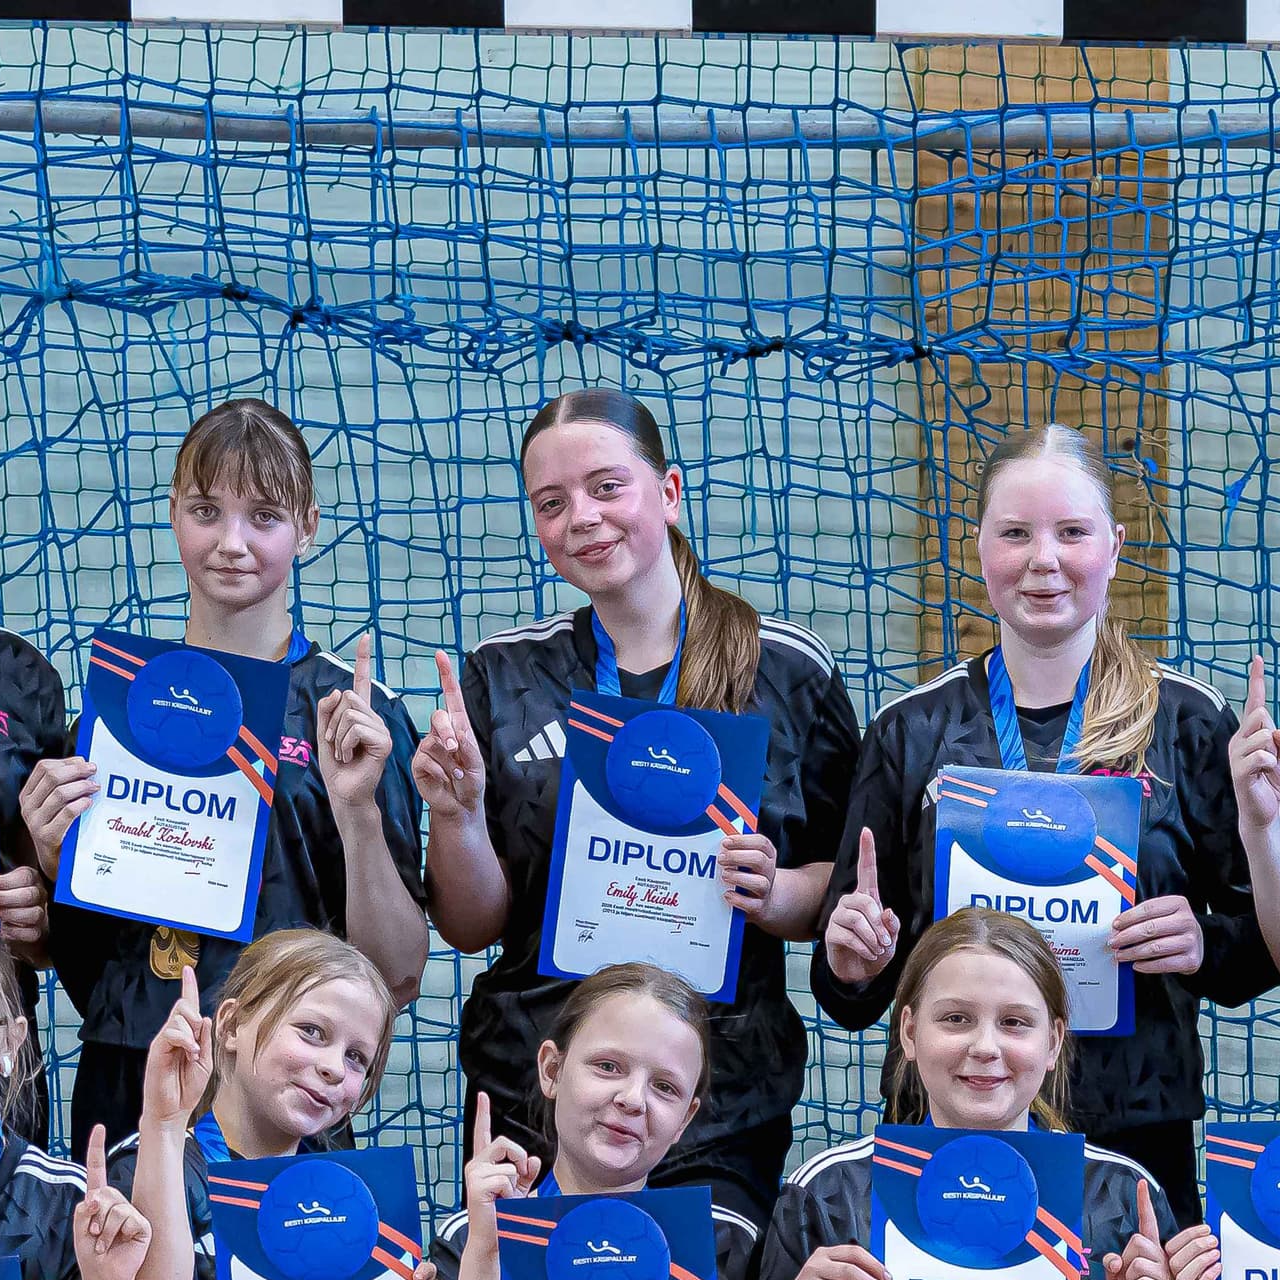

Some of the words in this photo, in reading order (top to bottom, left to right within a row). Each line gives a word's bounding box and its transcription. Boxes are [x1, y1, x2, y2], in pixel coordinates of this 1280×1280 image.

[106, 774, 237, 821] DIPLOM
[588, 836, 716, 879] DIPLOM
[606, 881, 638, 906] Emily
[970, 893, 1099, 925] DIPLOM
